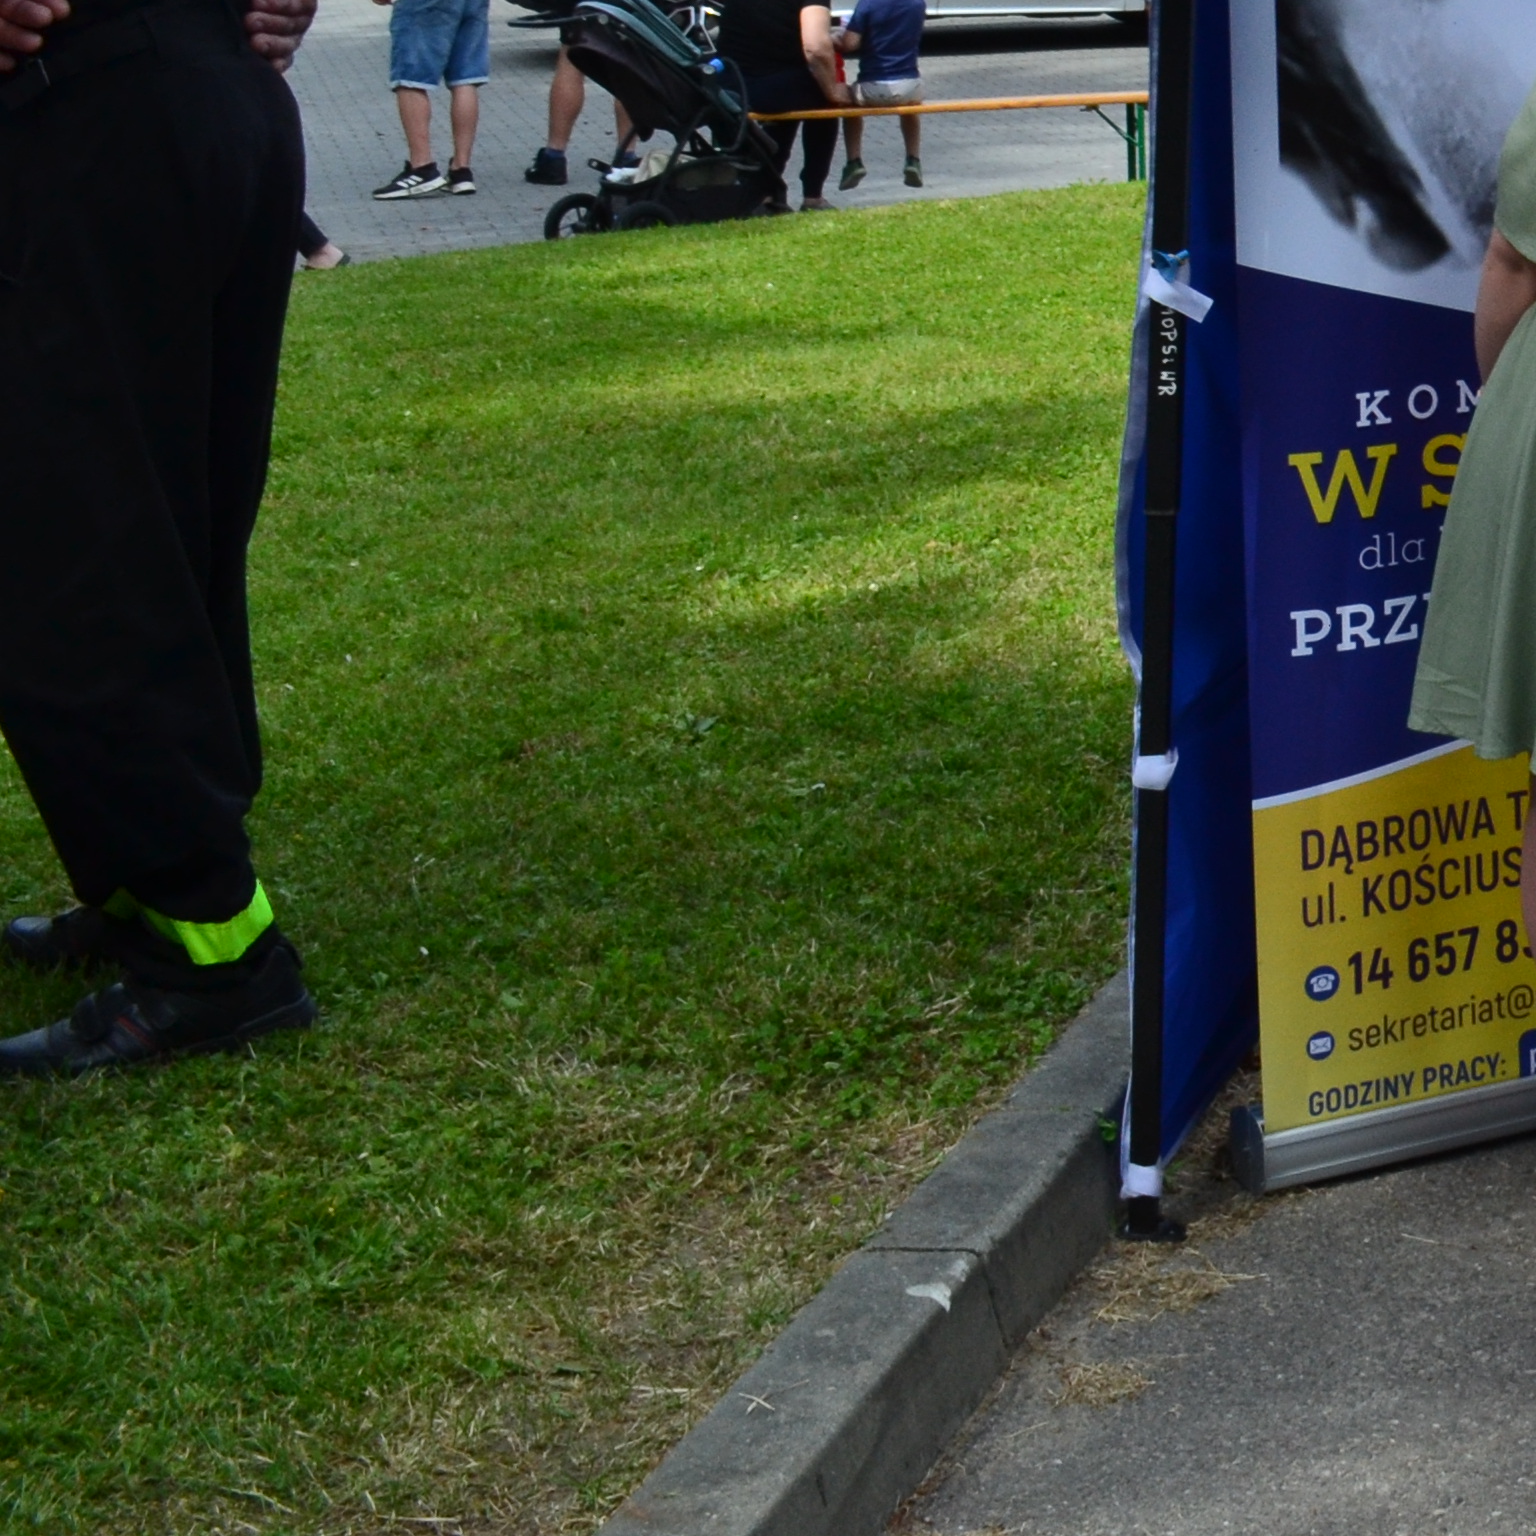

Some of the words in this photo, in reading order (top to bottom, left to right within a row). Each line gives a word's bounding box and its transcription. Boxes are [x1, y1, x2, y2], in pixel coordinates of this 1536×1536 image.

[1359, 532, 1426, 570] dla
[1301, 796, 1496, 875] DĄBROWA
[1301, 882, 1347, 928] ul.
[1347, 947, 1394, 995] 14
[1407, 926, 1480, 983] 657
[1309, 1070, 1416, 1116] GODZINY
[1422, 1052, 1507, 1092] PRACY:
